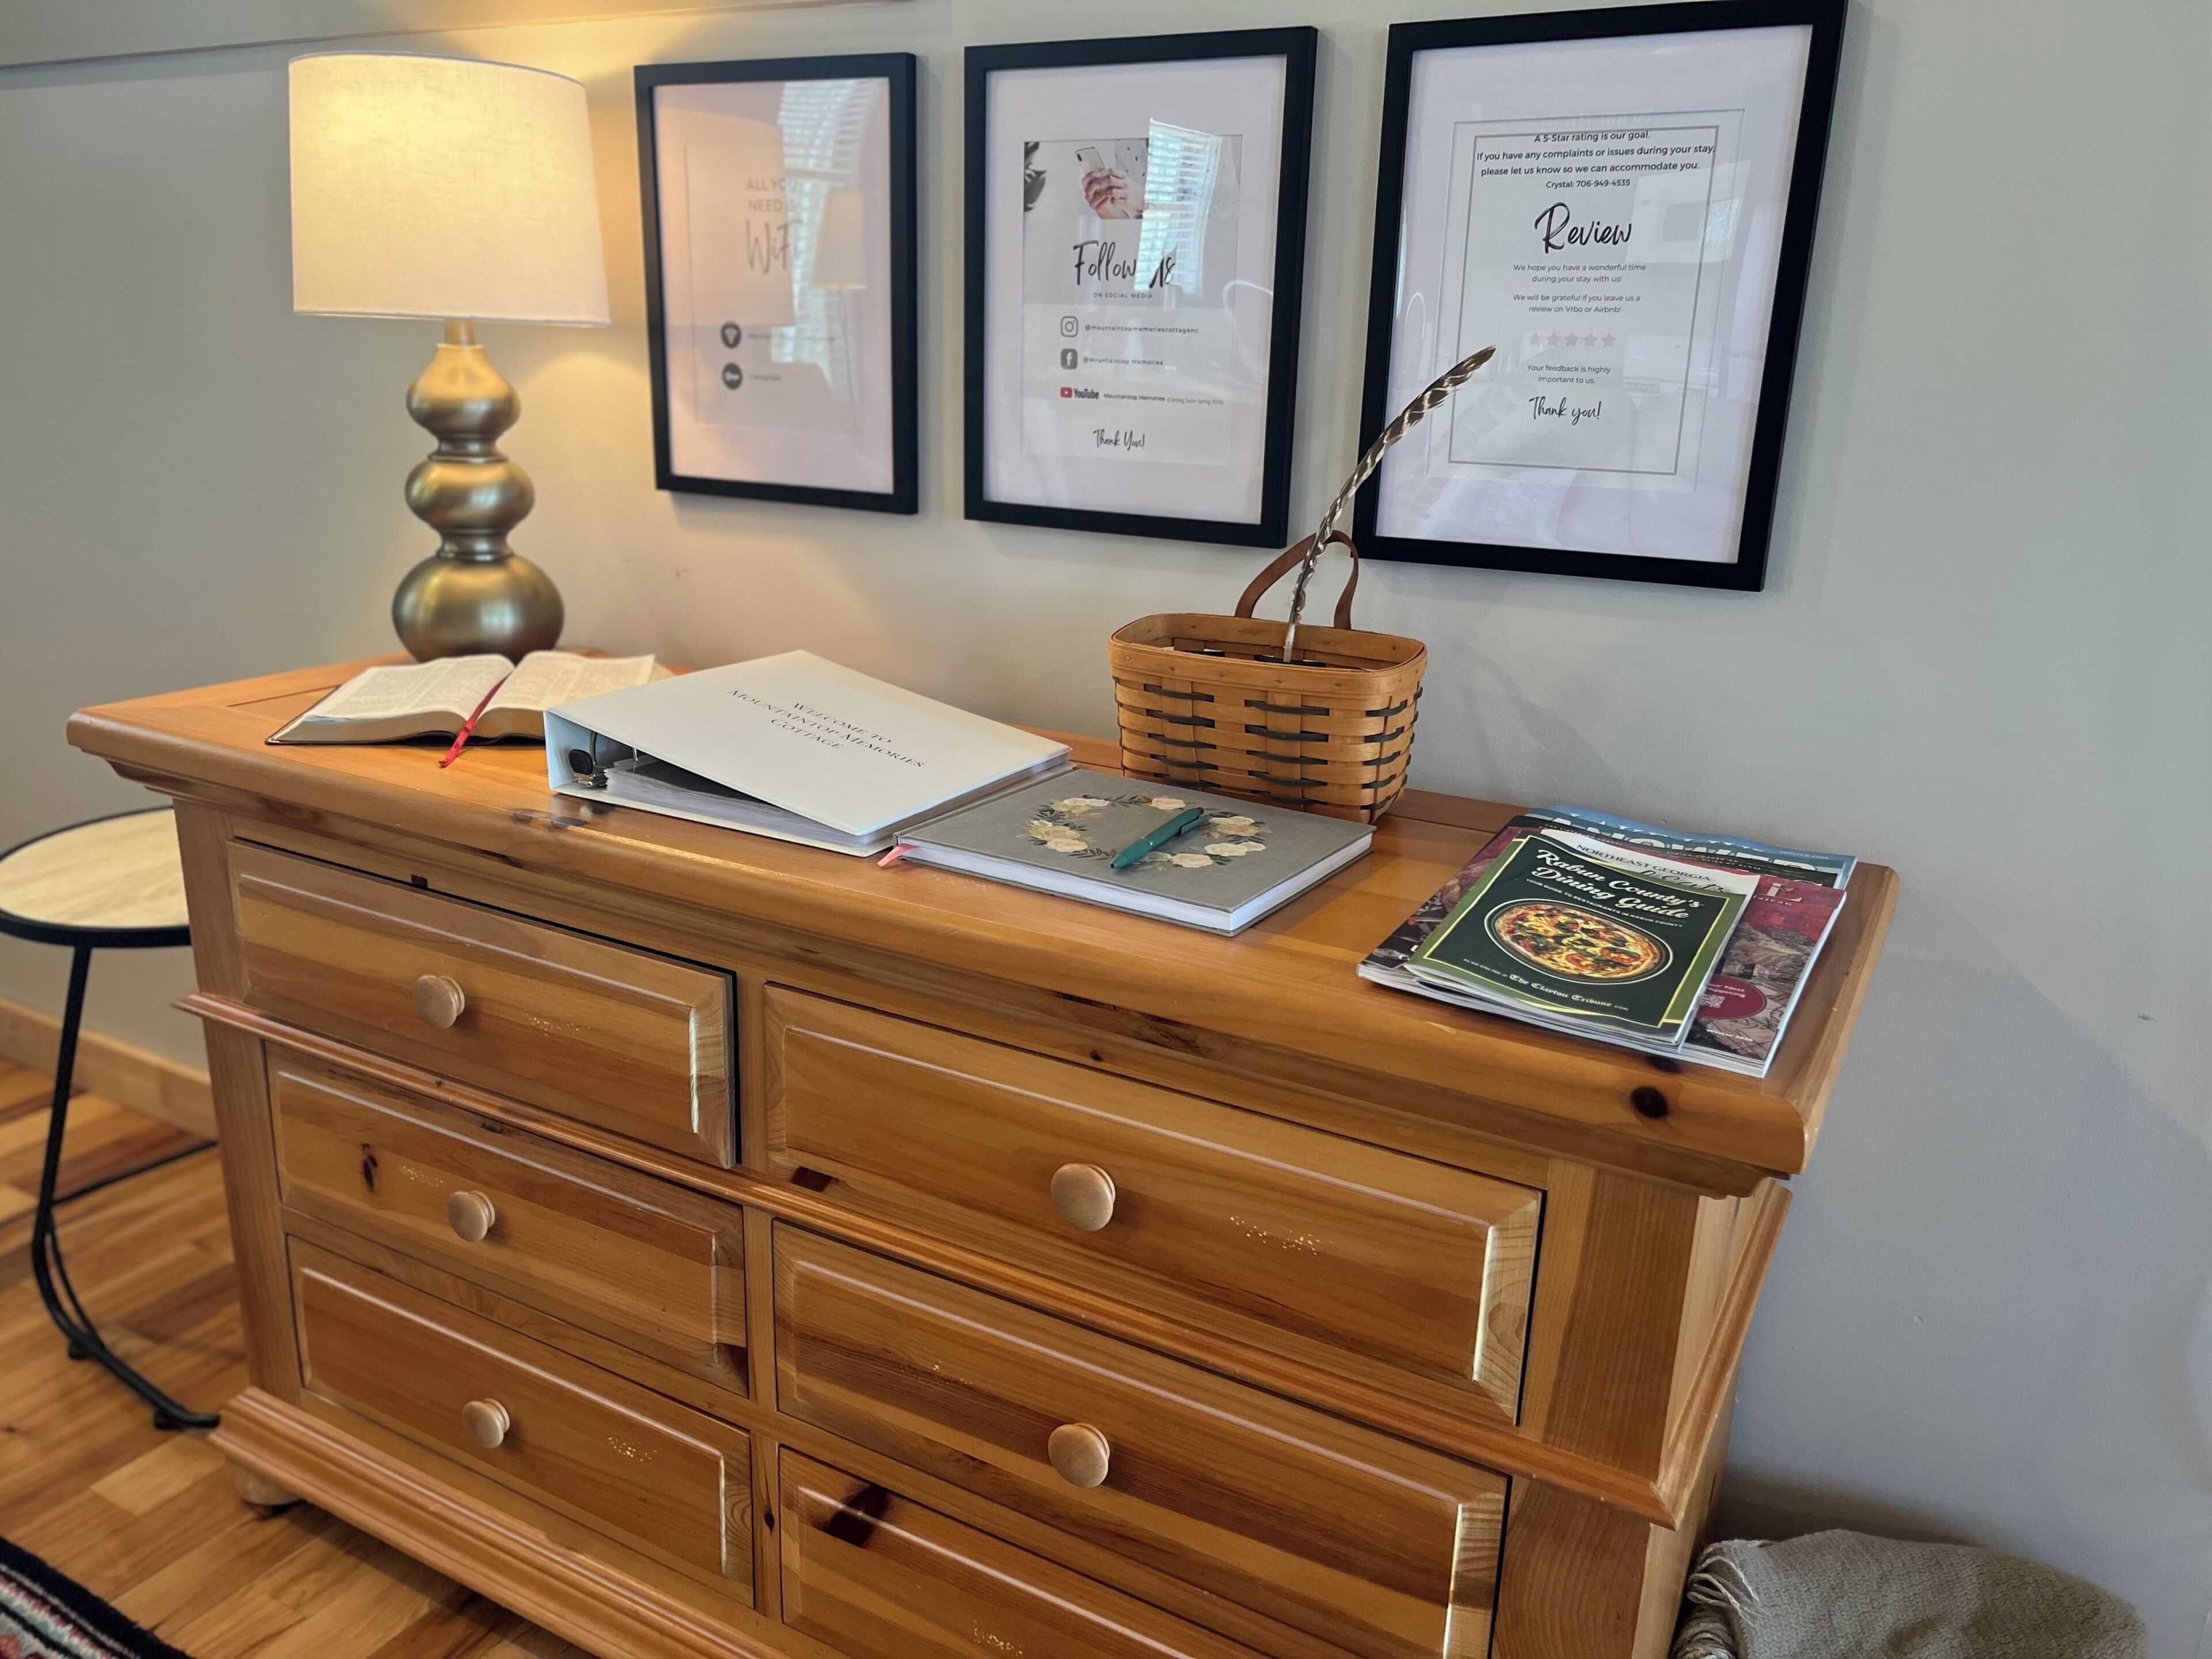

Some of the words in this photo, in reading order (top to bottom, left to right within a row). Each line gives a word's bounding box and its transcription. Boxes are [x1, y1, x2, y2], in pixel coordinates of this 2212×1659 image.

[1534, 134, 1541, 142] A
[1543, 132, 1571, 142] 5-Star
[1571, 131, 1599, 142] rating
[1601, 130, 1608, 140] is
[1628, 130, 1651, 141] goal.
[1484, 154, 1500, 162] you
[1543, 149, 1593, 159] complaints
[1608, 147, 1634, 156] issues
[1637, 146, 1668, 156] during
[1670, 147, 1692, 156] your
[1481, 168, 1508, 177] please
[1609, 162, 1677, 171] accommodate
[1680, 163, 1699, 171] you.
[747, 178, 768, 191] ALL
[1546, 181, 1574, 190] Crystal:
[1577, 179, 1630, 187] 706-949-4535
[748, 199, 783, 212] NEED
[1535, 202, 1631, 253] Review
[1073, 240, 1136, 285] Follow
[1532, 275, 1556, 283] during
[1588, 366, 1611, 374] highly
[1074, 388, 1099, 399] YouTube
[1529, 396, 1566, 419] Thank
[1572, 401, 1601, 425] you!
[1093, 429, 1120, 448] Thank
[1124, 430, 1145, 451] You!
[726, 690, 839, 734] MOUNTAINTOP
[840, 733, 925, 767] MEMORIES
[771, 718, 843, 749] COTTAGE
[793, 702, 866, 736] WELCOME
[870, 733, 890, 743] TO
[1576, 844, 1650, 868] NORTHEAST
[1653, 866, 1711, 881] GEORGIA
[1531, 866, 1615, 900] Dining
[1613, 897, 1690, 919] Guide
[1536, 849, 1607, 882] Rabun
[1608, 880, 1699, 908] County's
[1526, 878, 1543, 887] YOUR
[1543, 884, 1563, 895] GUIDE
[1573, 896, 1620, 915] RESTAURANTS
[1629, 914, 1654, 923] RABUN
[1654, 920, 1684, 928] COUNTY
[1463, 958, 1479, 967] ALSO
[1479, 964, 1501, 975] ONLINE
[1509, 974, 1529, 985] The
[1531, 982, 1570, 998] Clayton
[1571, 994, 1612, 1007] Tribune
